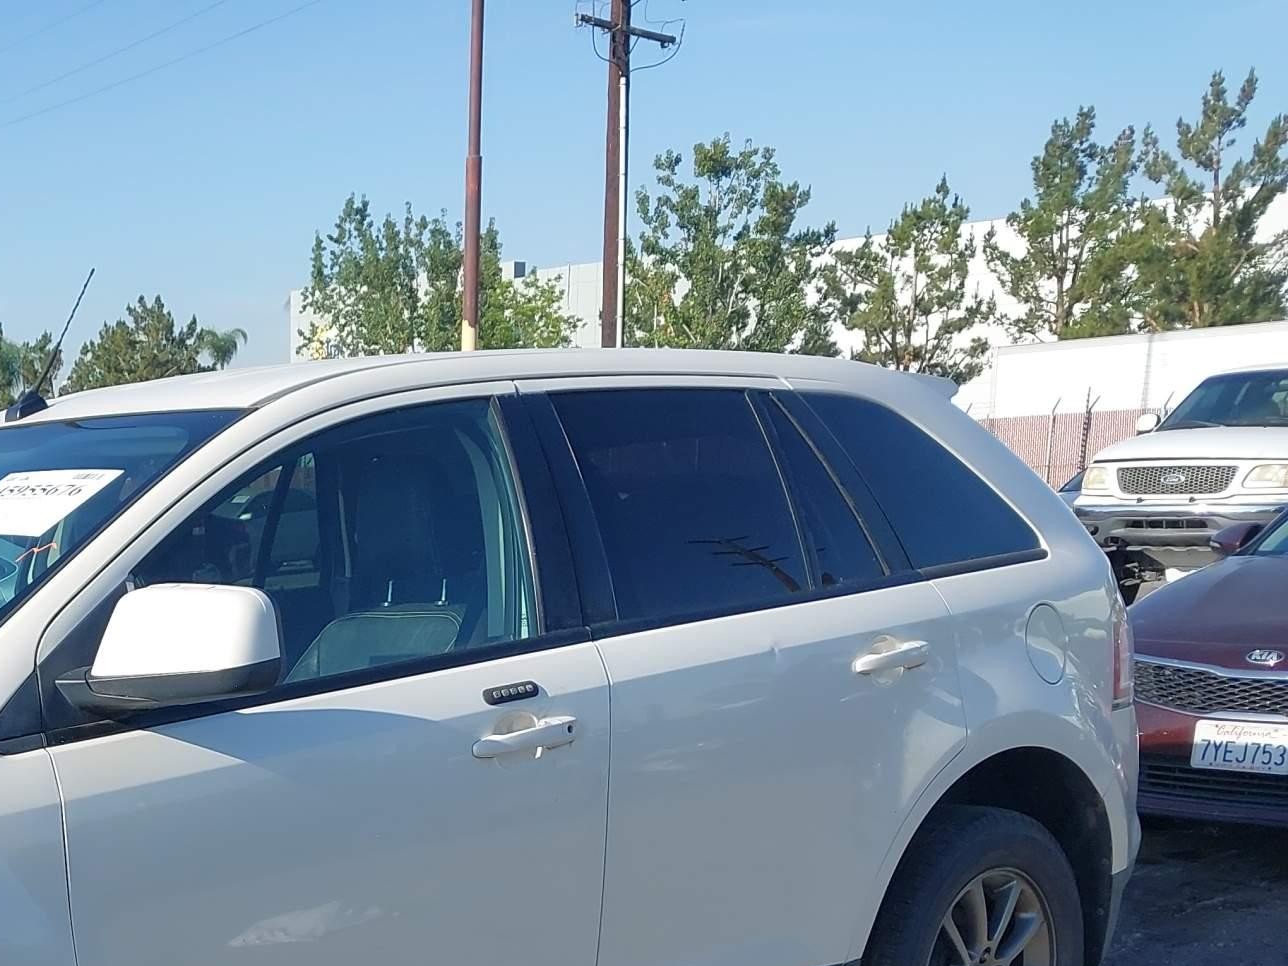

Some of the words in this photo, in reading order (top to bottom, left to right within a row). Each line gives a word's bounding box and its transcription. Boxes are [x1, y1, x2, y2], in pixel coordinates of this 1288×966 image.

[1251, 650, 1279, 661] KIA
[1216, 724, 1273, 739] California
[1200, 739, 1287, 766] 7YEJ753
